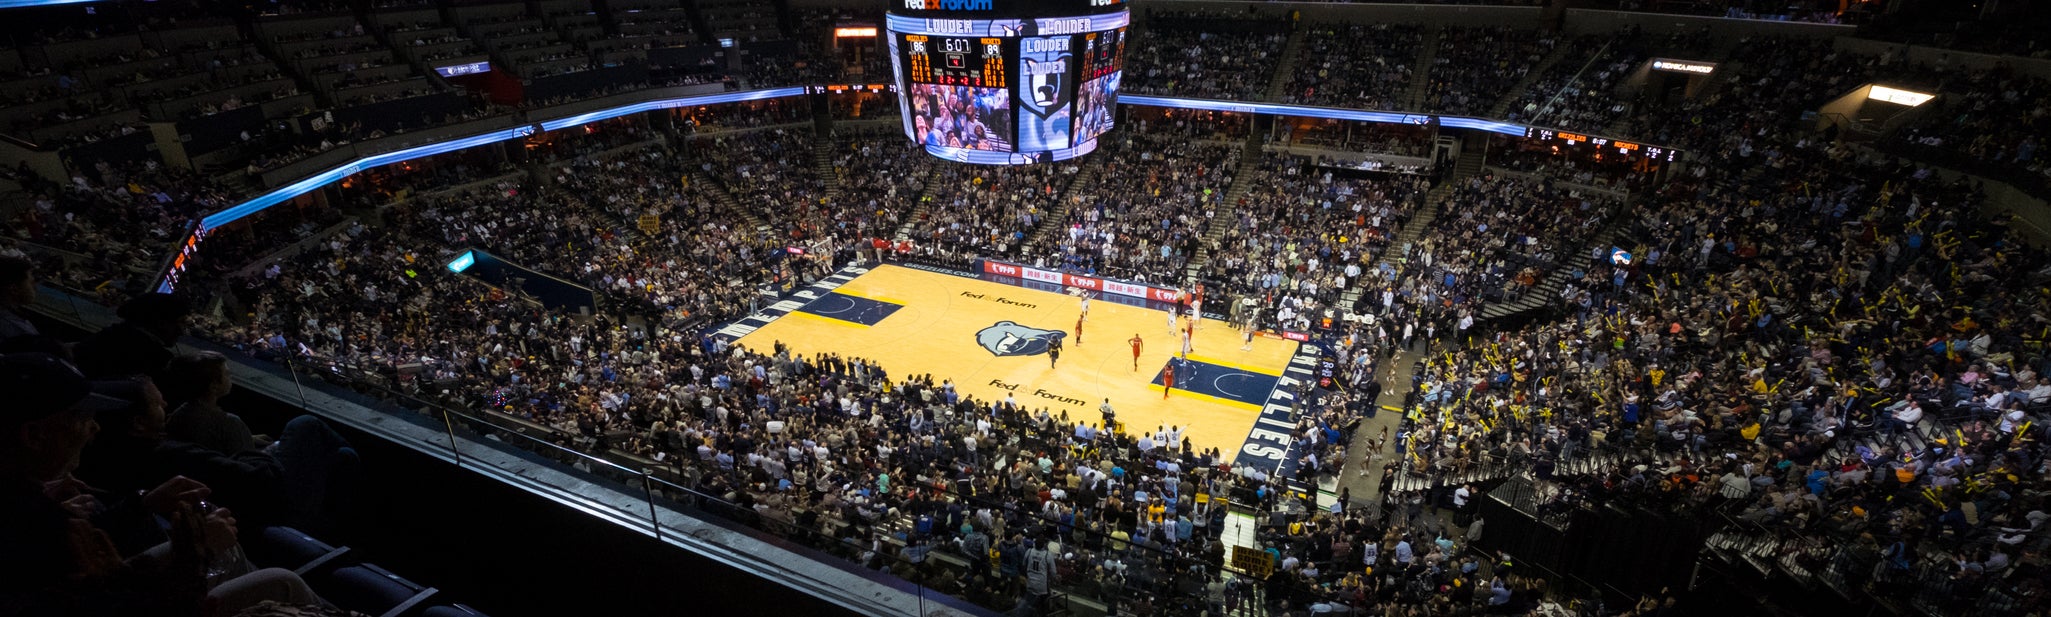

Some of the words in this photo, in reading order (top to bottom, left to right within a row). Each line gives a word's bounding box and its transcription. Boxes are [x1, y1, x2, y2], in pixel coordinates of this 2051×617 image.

[926, 18, 973, 33] LOUDER
[1045, 18, 1092, 34] LOUDER
[945, 38, 970, 51] 6:07
[987, 44, 999, 54] 89
[1026, 38, 1069, 52] LOUDER
[1023, 61, 1066, 76] LOUDER
